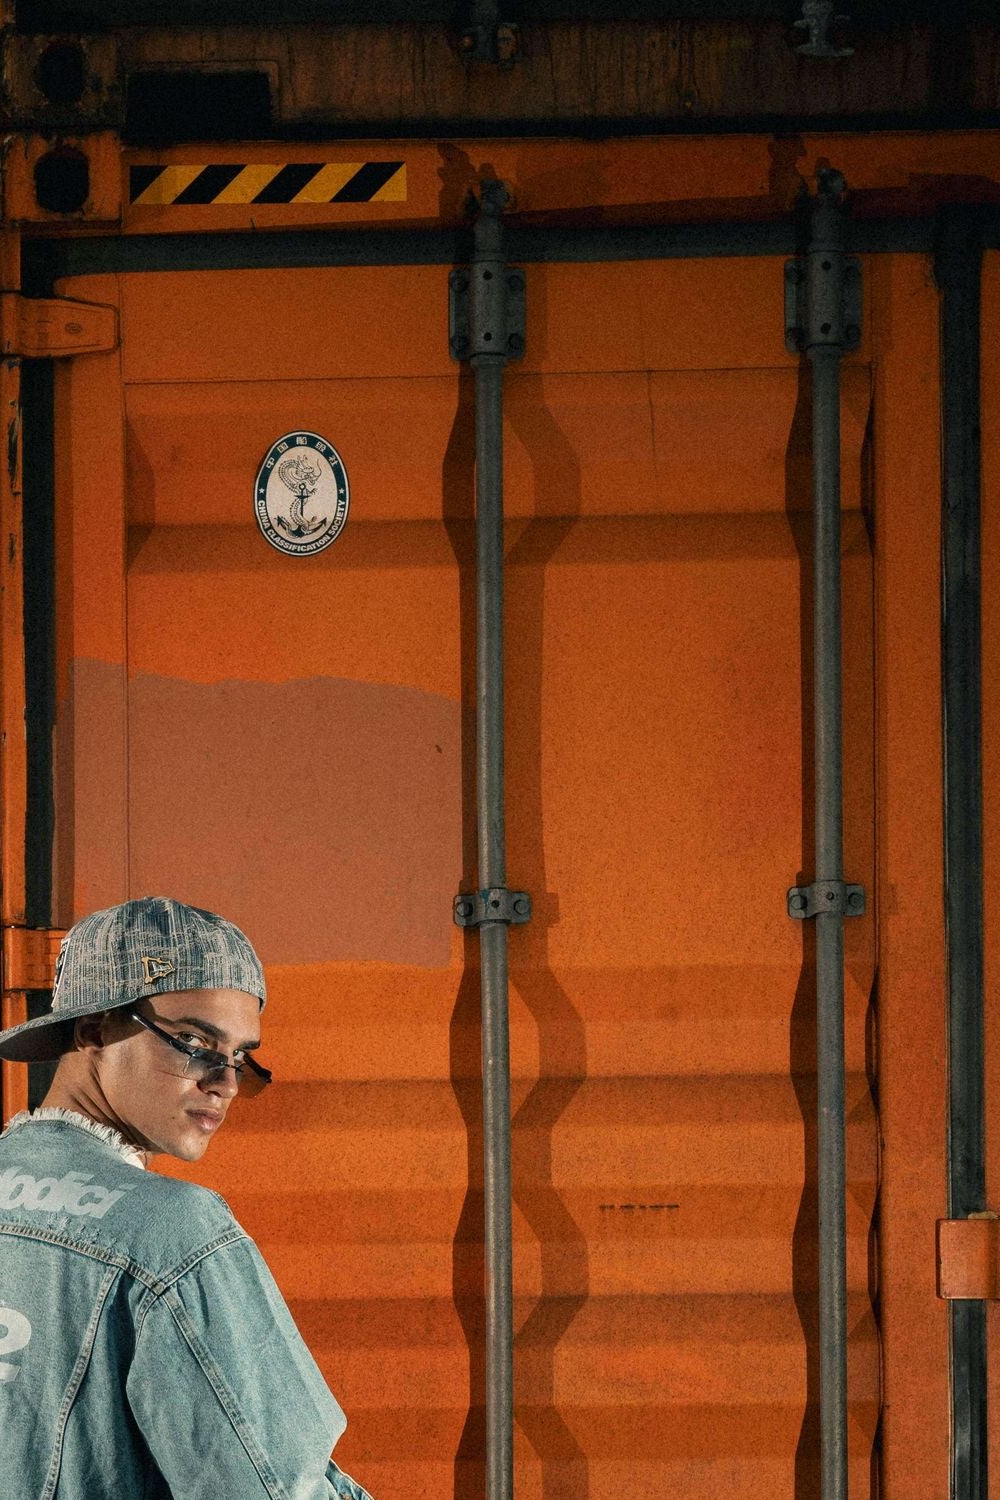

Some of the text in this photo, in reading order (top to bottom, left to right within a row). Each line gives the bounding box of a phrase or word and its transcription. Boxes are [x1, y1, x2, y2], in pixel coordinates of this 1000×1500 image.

[258, 500, 346, 552] CHINA CLASSIFICATION SOCIETY
